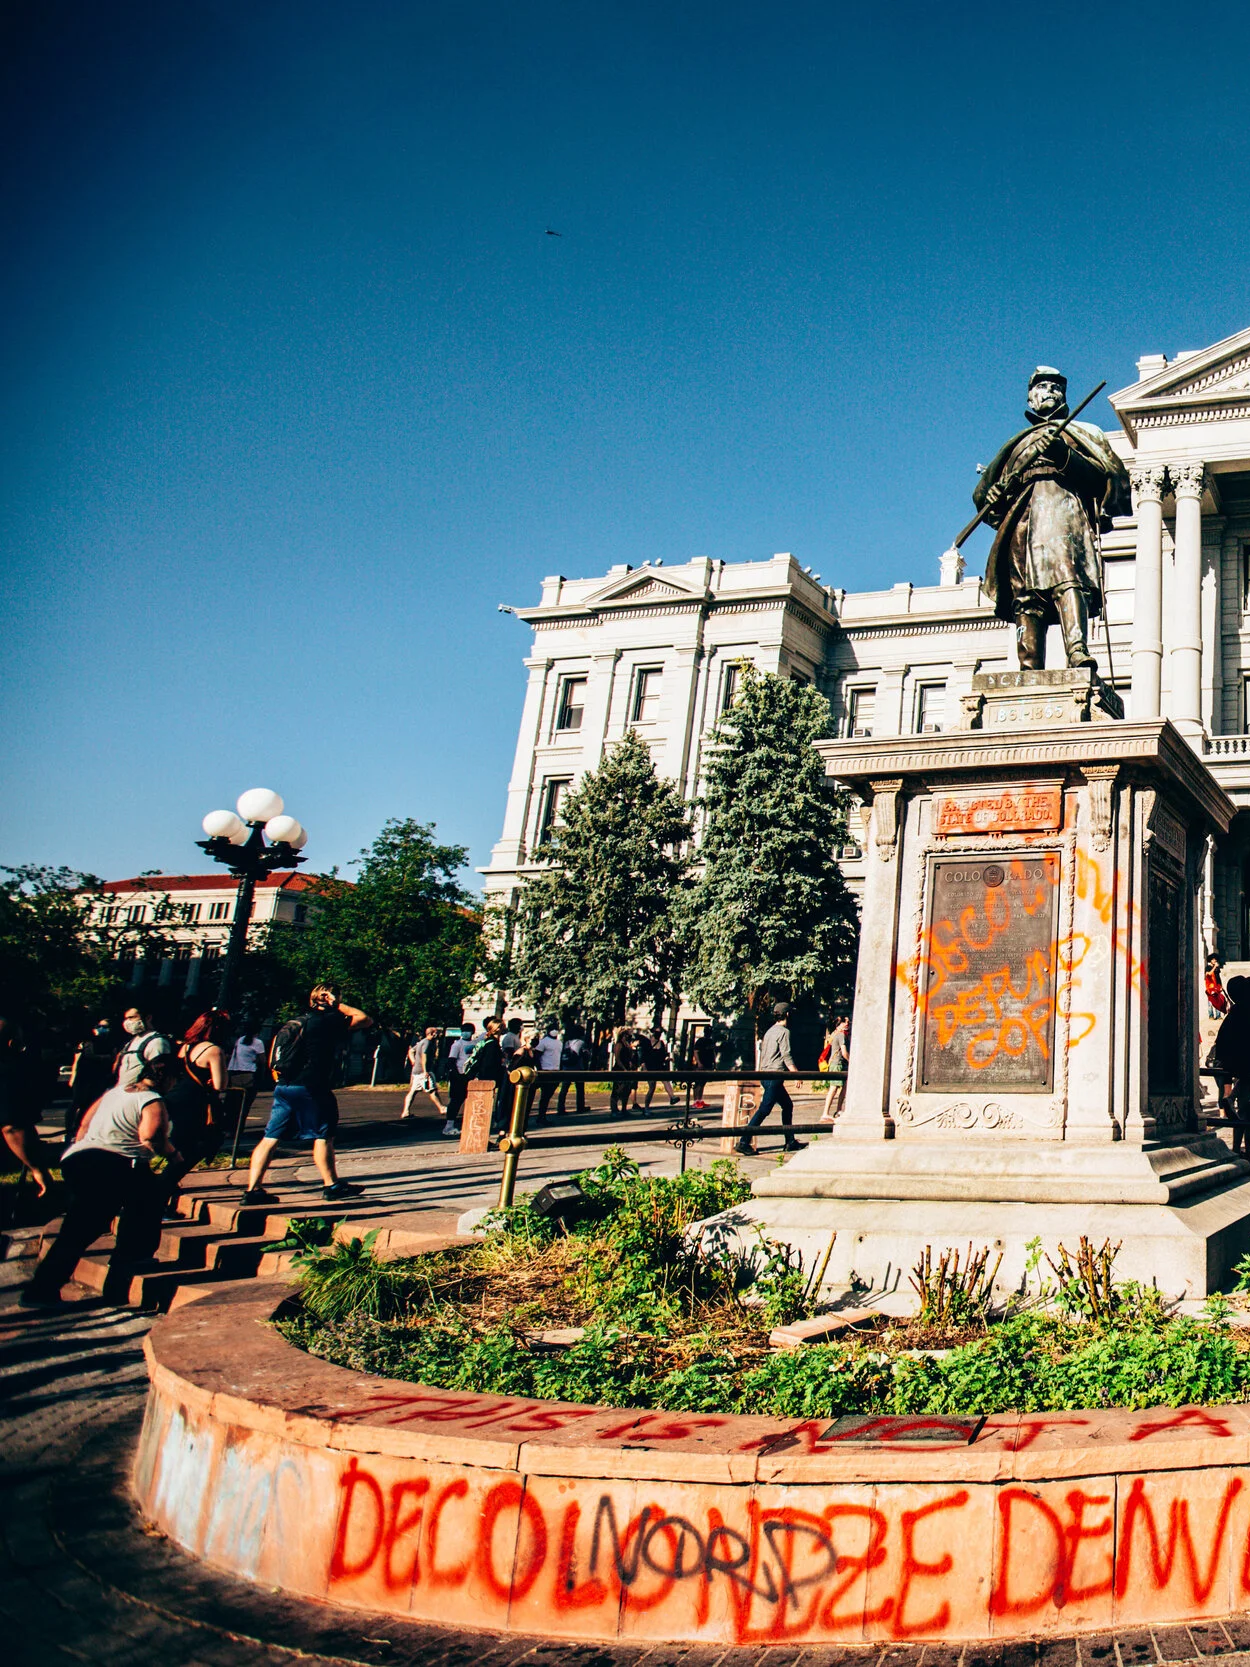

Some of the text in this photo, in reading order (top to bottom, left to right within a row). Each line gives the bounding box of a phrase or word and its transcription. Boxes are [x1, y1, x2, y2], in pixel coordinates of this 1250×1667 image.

[1005, 798, 1021, 809] BY
[1023, 796, 1049, 808] THE
[940, 813, 972, 825] STATE
[975, 812, 989, 823] OF
[932, 932, 1091, 1048] DEFUND
[329, 1394, 597, 1432] THIS
[599, 1414, 729, 1441] IS
[1129, 1408, 1234, 1441] A
